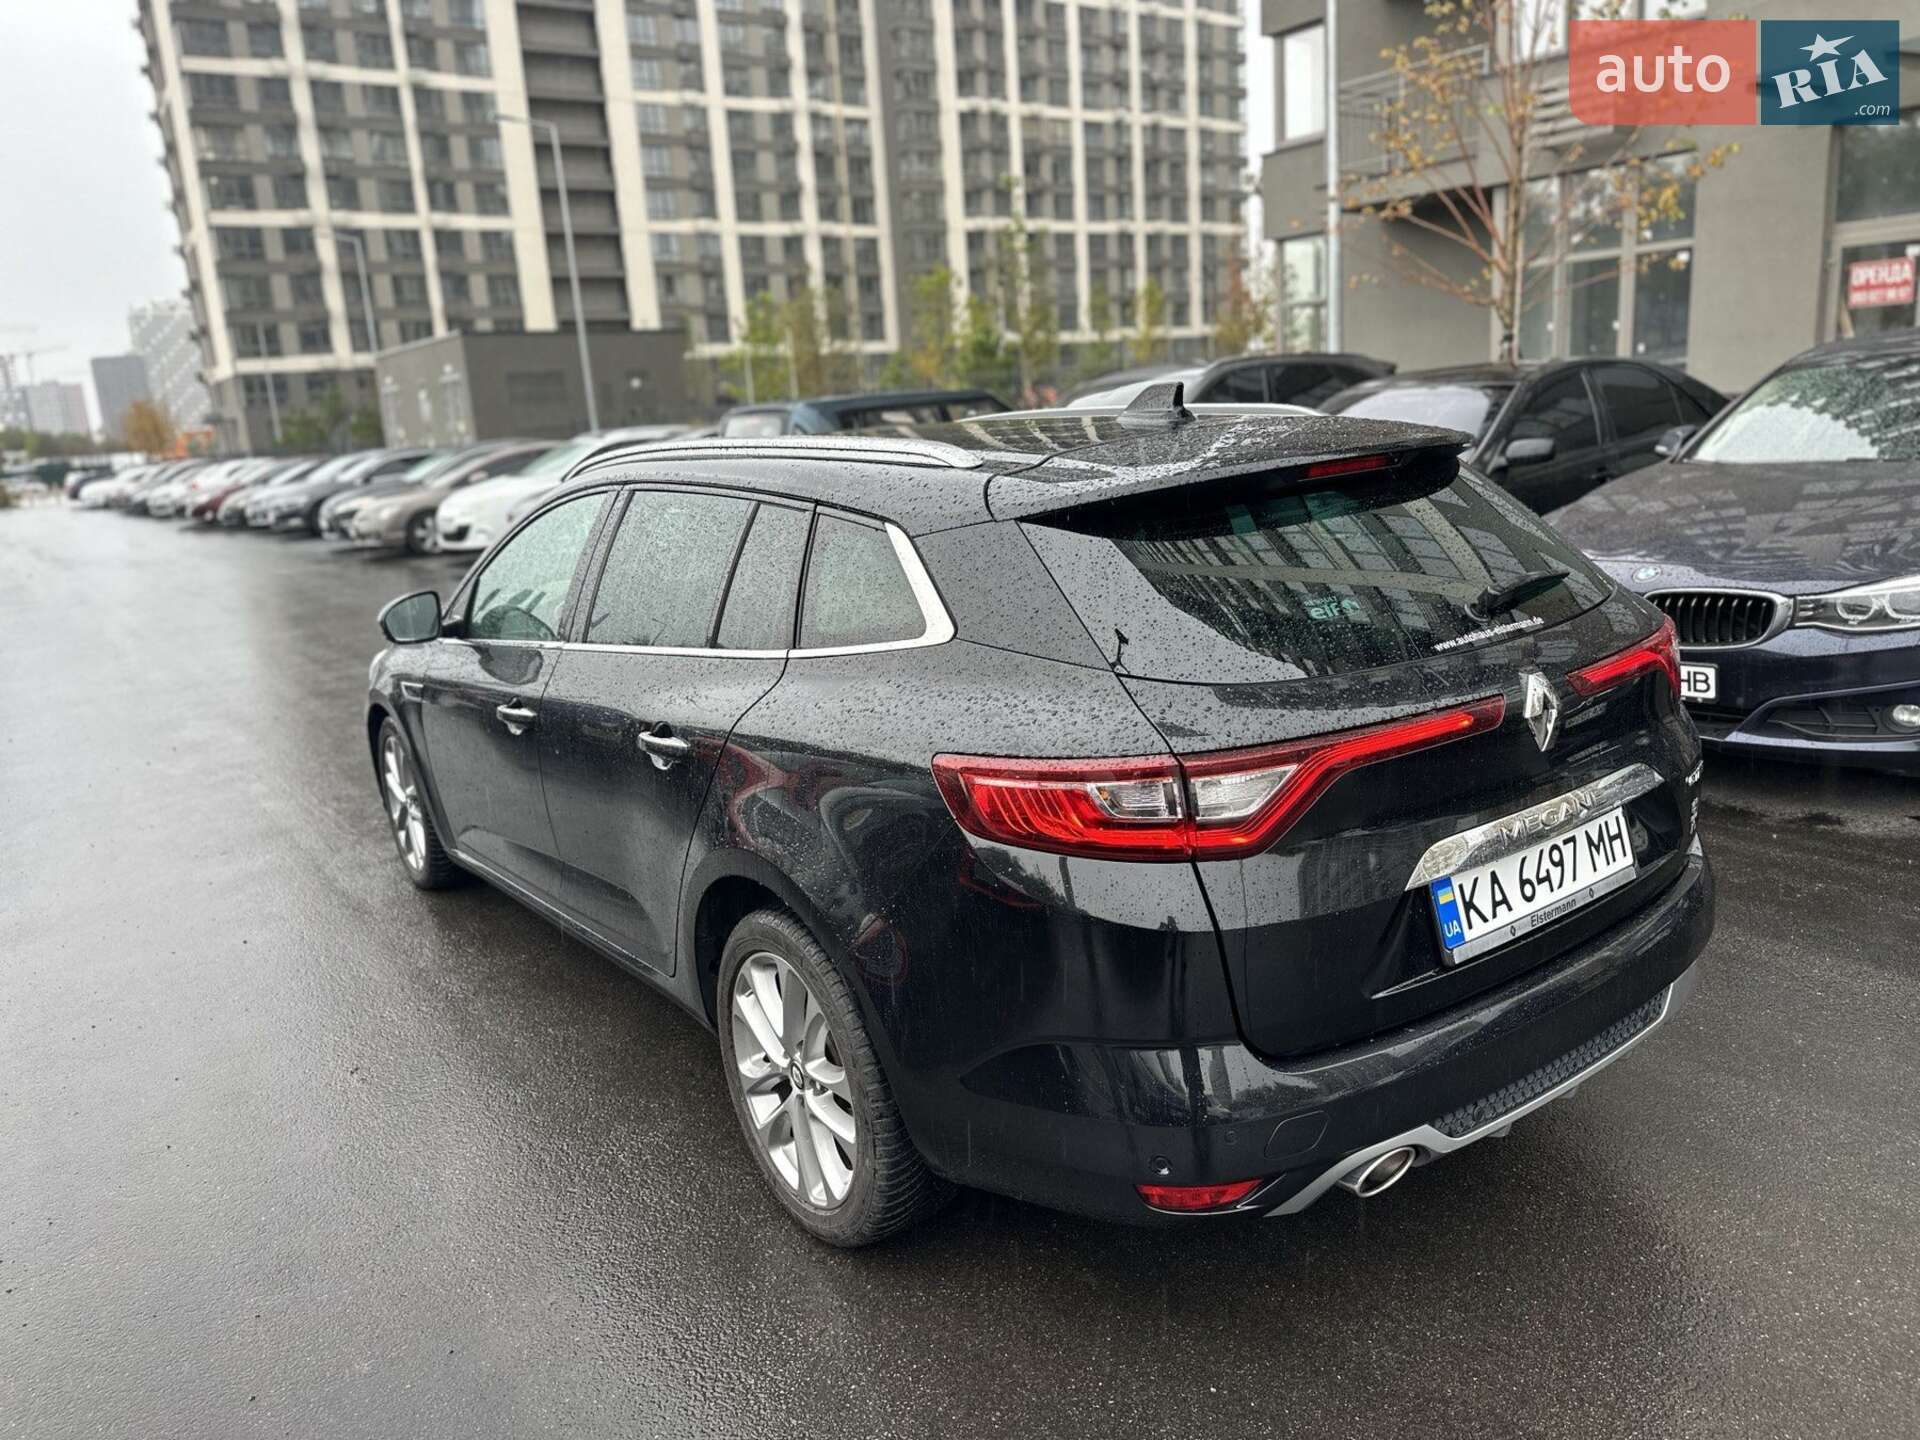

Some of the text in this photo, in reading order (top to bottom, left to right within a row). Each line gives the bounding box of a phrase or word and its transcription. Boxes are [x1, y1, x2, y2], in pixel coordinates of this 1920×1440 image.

[1310, 602, 1340, 619] elf
[1458, 869, 1513, 930] KA
[1518, 835, 1577, 903] 6497
[1585, 815, 1627, 873] MH
[1530, 899, 1577, 928] Elstermann
[1444, 919, 1461, 937] UA
